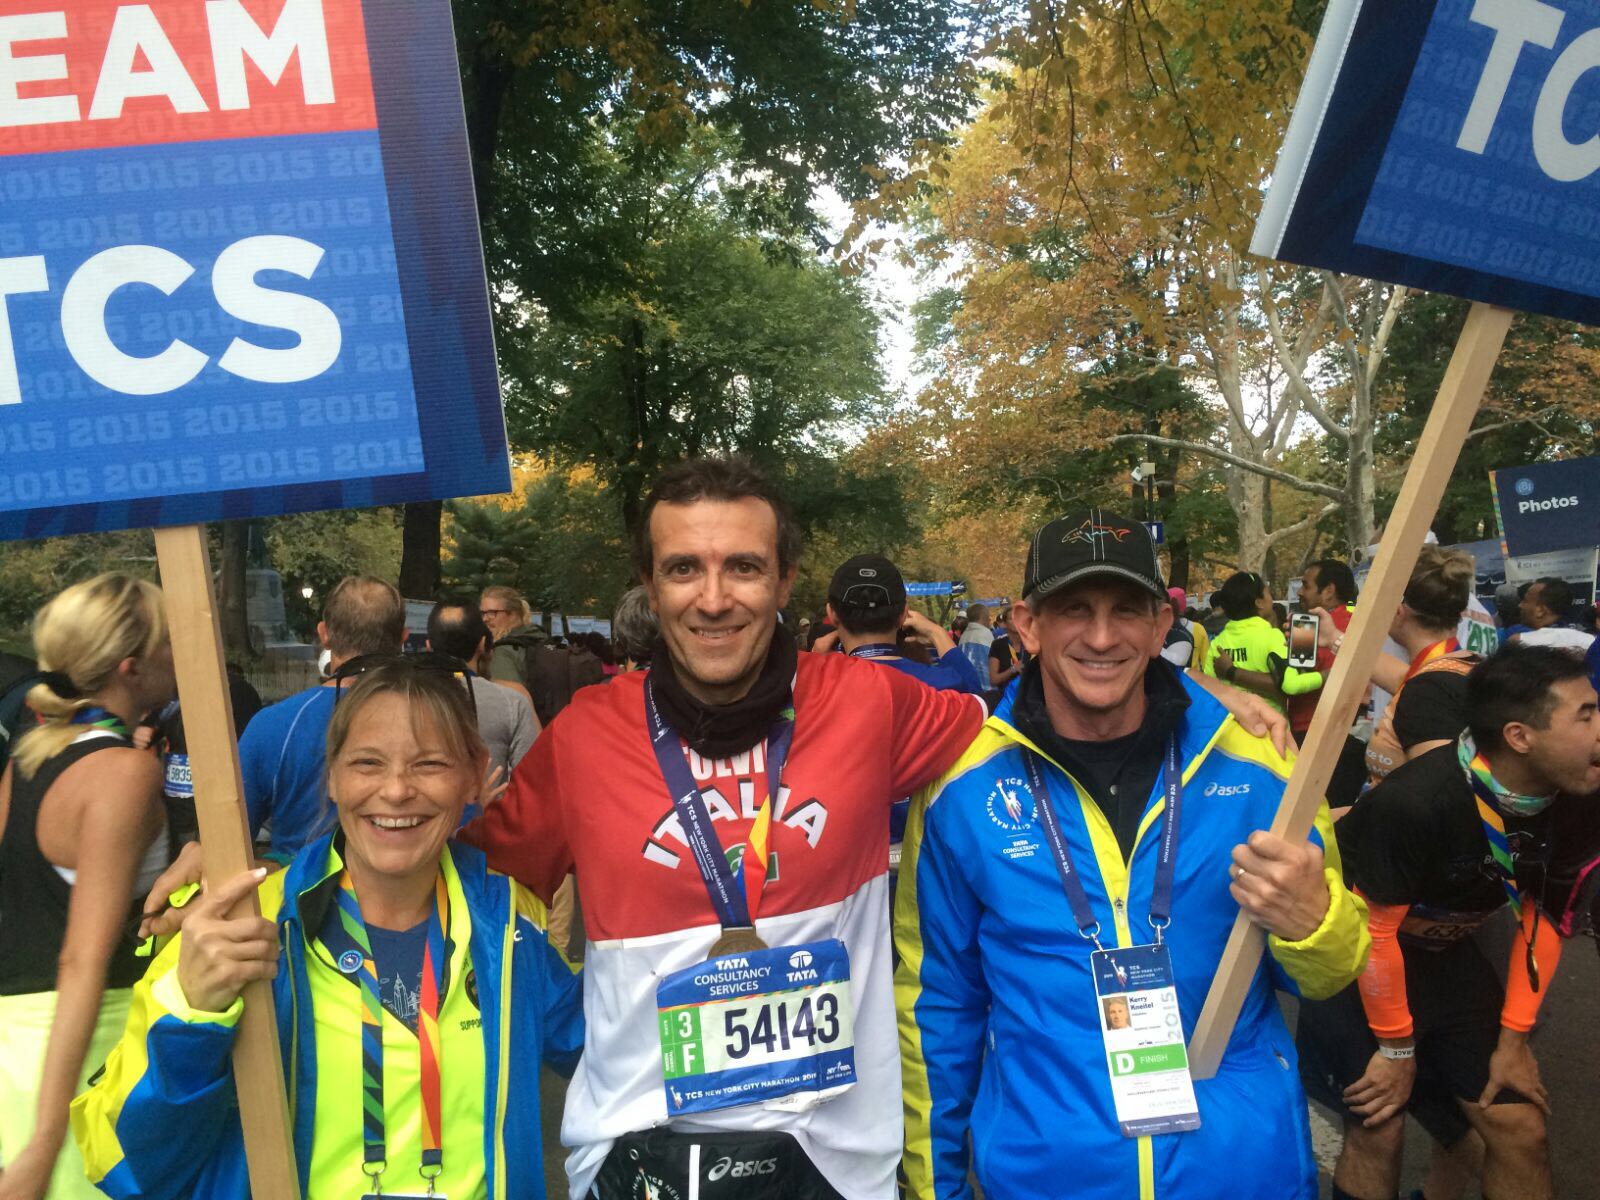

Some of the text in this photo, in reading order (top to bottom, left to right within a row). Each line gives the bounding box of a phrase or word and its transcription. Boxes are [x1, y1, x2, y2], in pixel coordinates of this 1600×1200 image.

[96, 157, 200, 193] 2015
[213, 149, 314, 186] 2015
[154, 204, 256, 239] 2015
[68, 410, 171, 447] 2015
[185, 400, 287, 437] 2015
[300, 390, 400, 426] 2015
[103, 457, 207, 494] 2015
[219, 446, 321, 482] 2015
[1518, 495, 1579, 514] Photos
[641, 777, 829, 870] ITALIA
[687, 804, 697, 821] TCS
[699, 836, 709, 853] YORK
[706, 853, 716, 868] CITY
[712, 867, 729, 904] MARATHON
[694, 966, 772, 986] CONSULTANCY
[715, 957, 750, 970] TATA
[786, 969, 818, 983] TATA
[709, 980, 759, 996] SERVICES
[678, 992, 841, 1060] 3 54143
[682, 1043, 697, 1074] F
[1116, 1053, 1169, 1074] D FINISH
[685, 1091, 704, 1100] TCS
[705, 1088, 722, 1097] NEW
[723, 1085, 743, 1095] YORK
[743, 1082, 760, 1092] CITY
[761, 1076, 800, 1088] MARATHON
